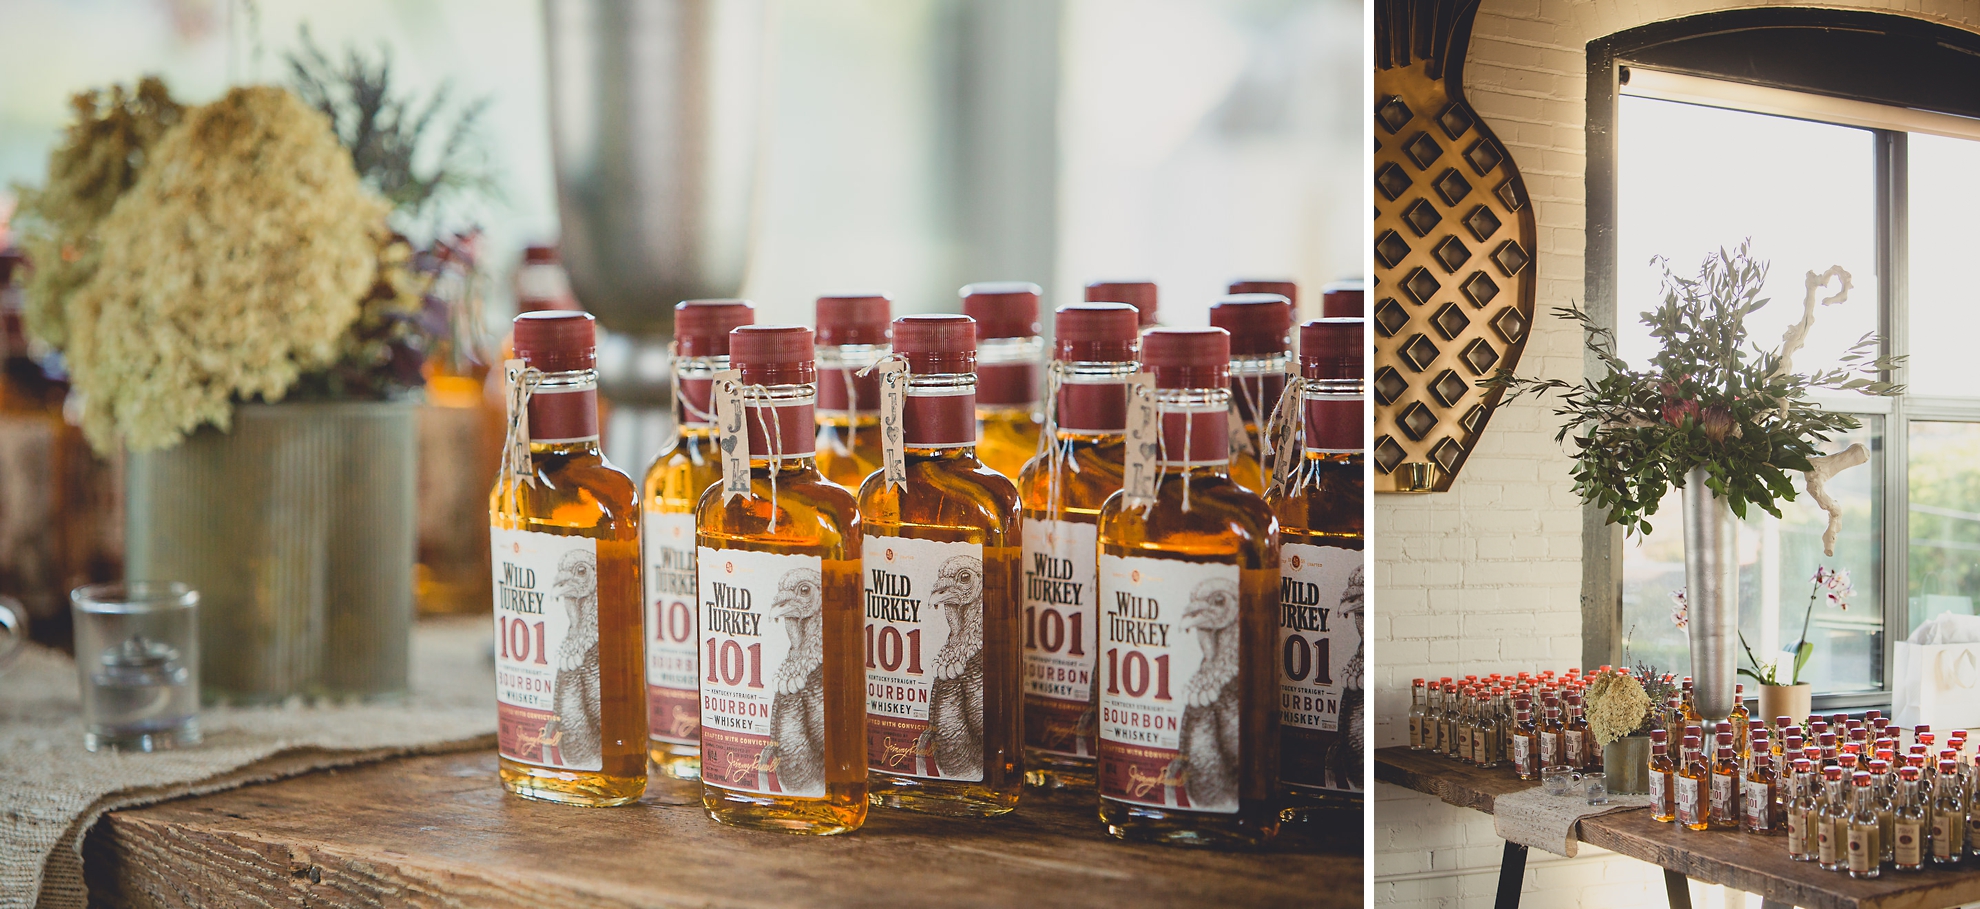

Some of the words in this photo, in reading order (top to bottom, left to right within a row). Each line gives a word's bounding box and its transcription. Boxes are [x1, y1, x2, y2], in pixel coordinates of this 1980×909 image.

[502, 561, 536, 590] WILD
[653, 563, 696, 597] TURKE
[1033, 551, 1073, 581] WILD
[712, 581, 752, 611] WILD
[871, 568, 911, 597] WILD
[1279, 576, 1320, 606] WILD
[1115, 591, 1159, 621] WILD
[1280, 603, 1330, 632] URKEY.
[655, 599, 697, 643] 10
[1025, 605, 1085, 656] 101
[499, 615, 548, 665] 101
[865, 623, 924, 675] 101
[706, 637, 765, 690] 101
[1280, 633, 1333, 686] 01
[499, 671, 551, 693] BOURBON
[890, 676, 916, 685] STRAIGHT
[1107, 648, 1173, 701] 101
[507, 691, 538, 704] WHISKEY
[711, 689, 732, 698] KENTUCKY
[733, 691, 757, 700] STRAIGHT
[867, 683, 927, 703] OURBON
[1280, 684, 1297, 693] TUCKY
[1297, 686, 1325, 695] STRAIGHT
[1281, 693, 1337, 714] URBON
[704, 695, 769, 718] BOURBON
[870, 700, 912, 715] WHISKEY
[1103, 707, 1177, 731] BOURBON
[714, 714, 754, 730] WHISKEY
[881, 720, 897, 728] WITH
[1114, 727, 1159, 743] WHISKEY
